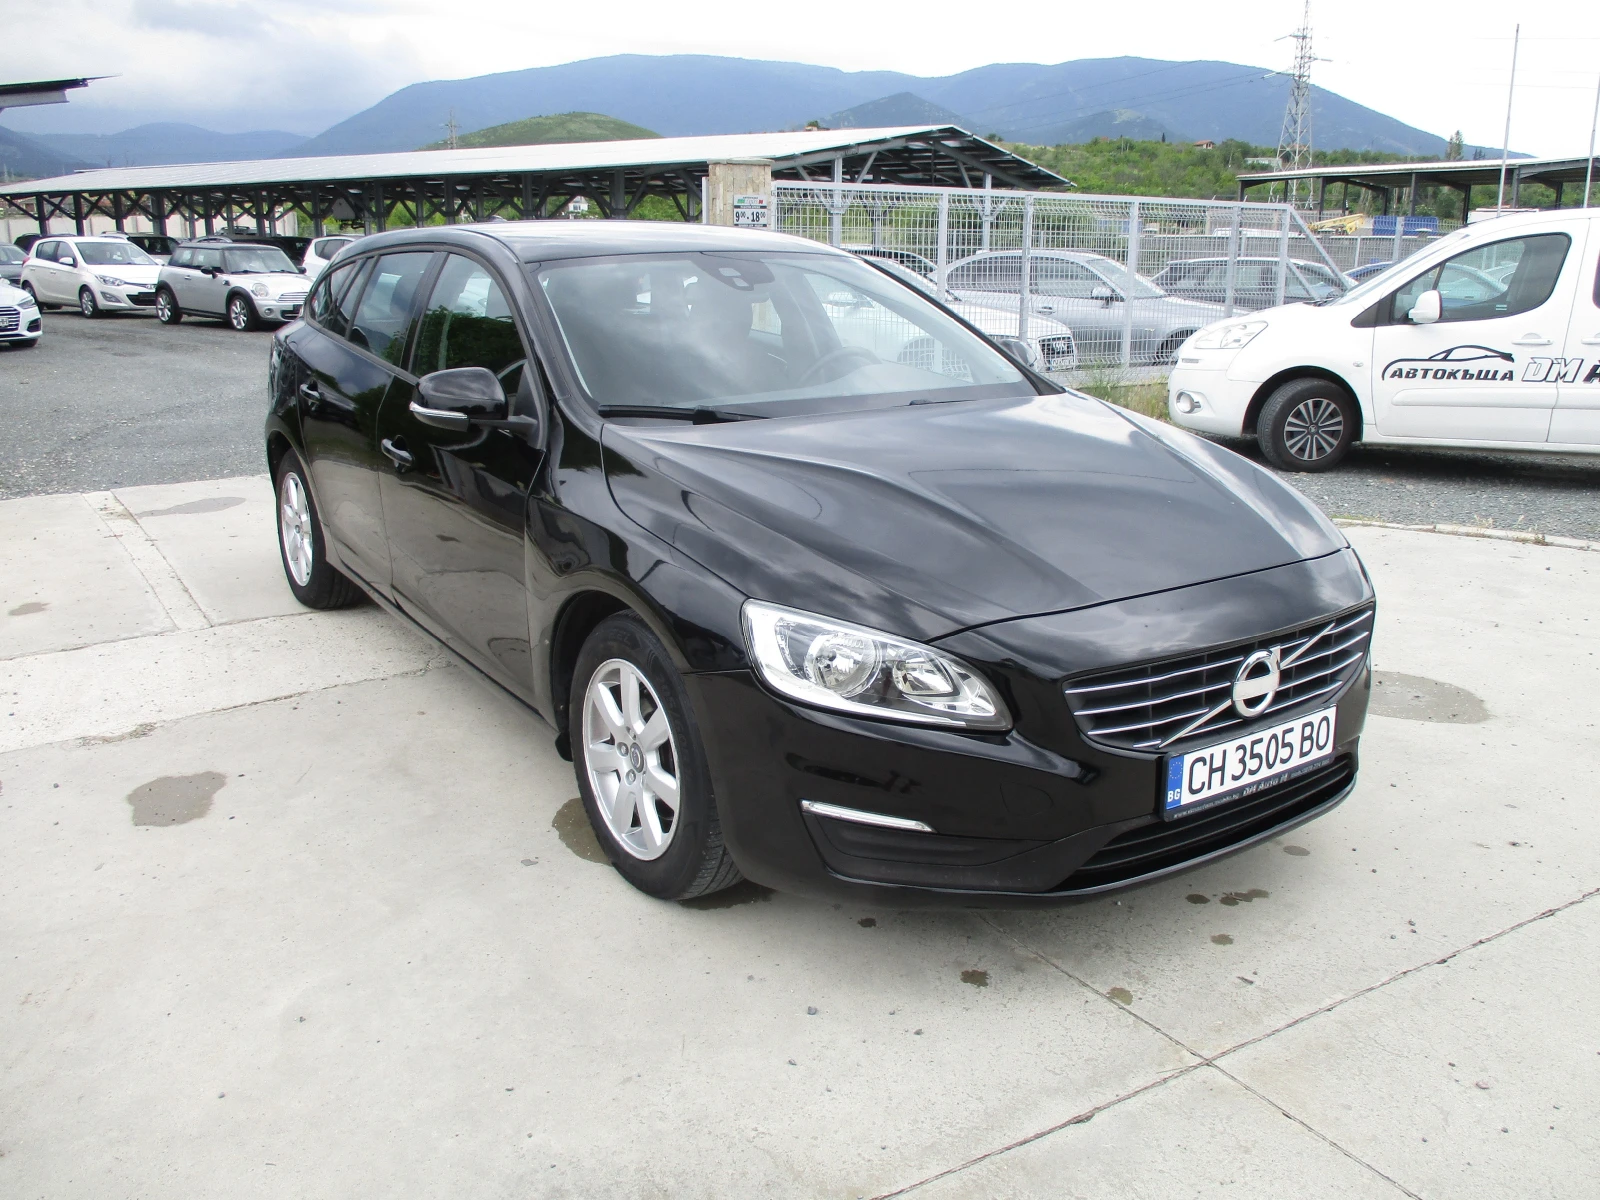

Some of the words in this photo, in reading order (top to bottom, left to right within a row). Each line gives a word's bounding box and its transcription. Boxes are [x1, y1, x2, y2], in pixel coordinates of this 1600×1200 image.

[1521, 357, 1584, 383] DM
[1188, 749, 1227, 795] CH
[1231, 727, 1294, 781] 3505
[1299, 715, 1330, 759] BO
[1167, 788, 1181, 803] BG
